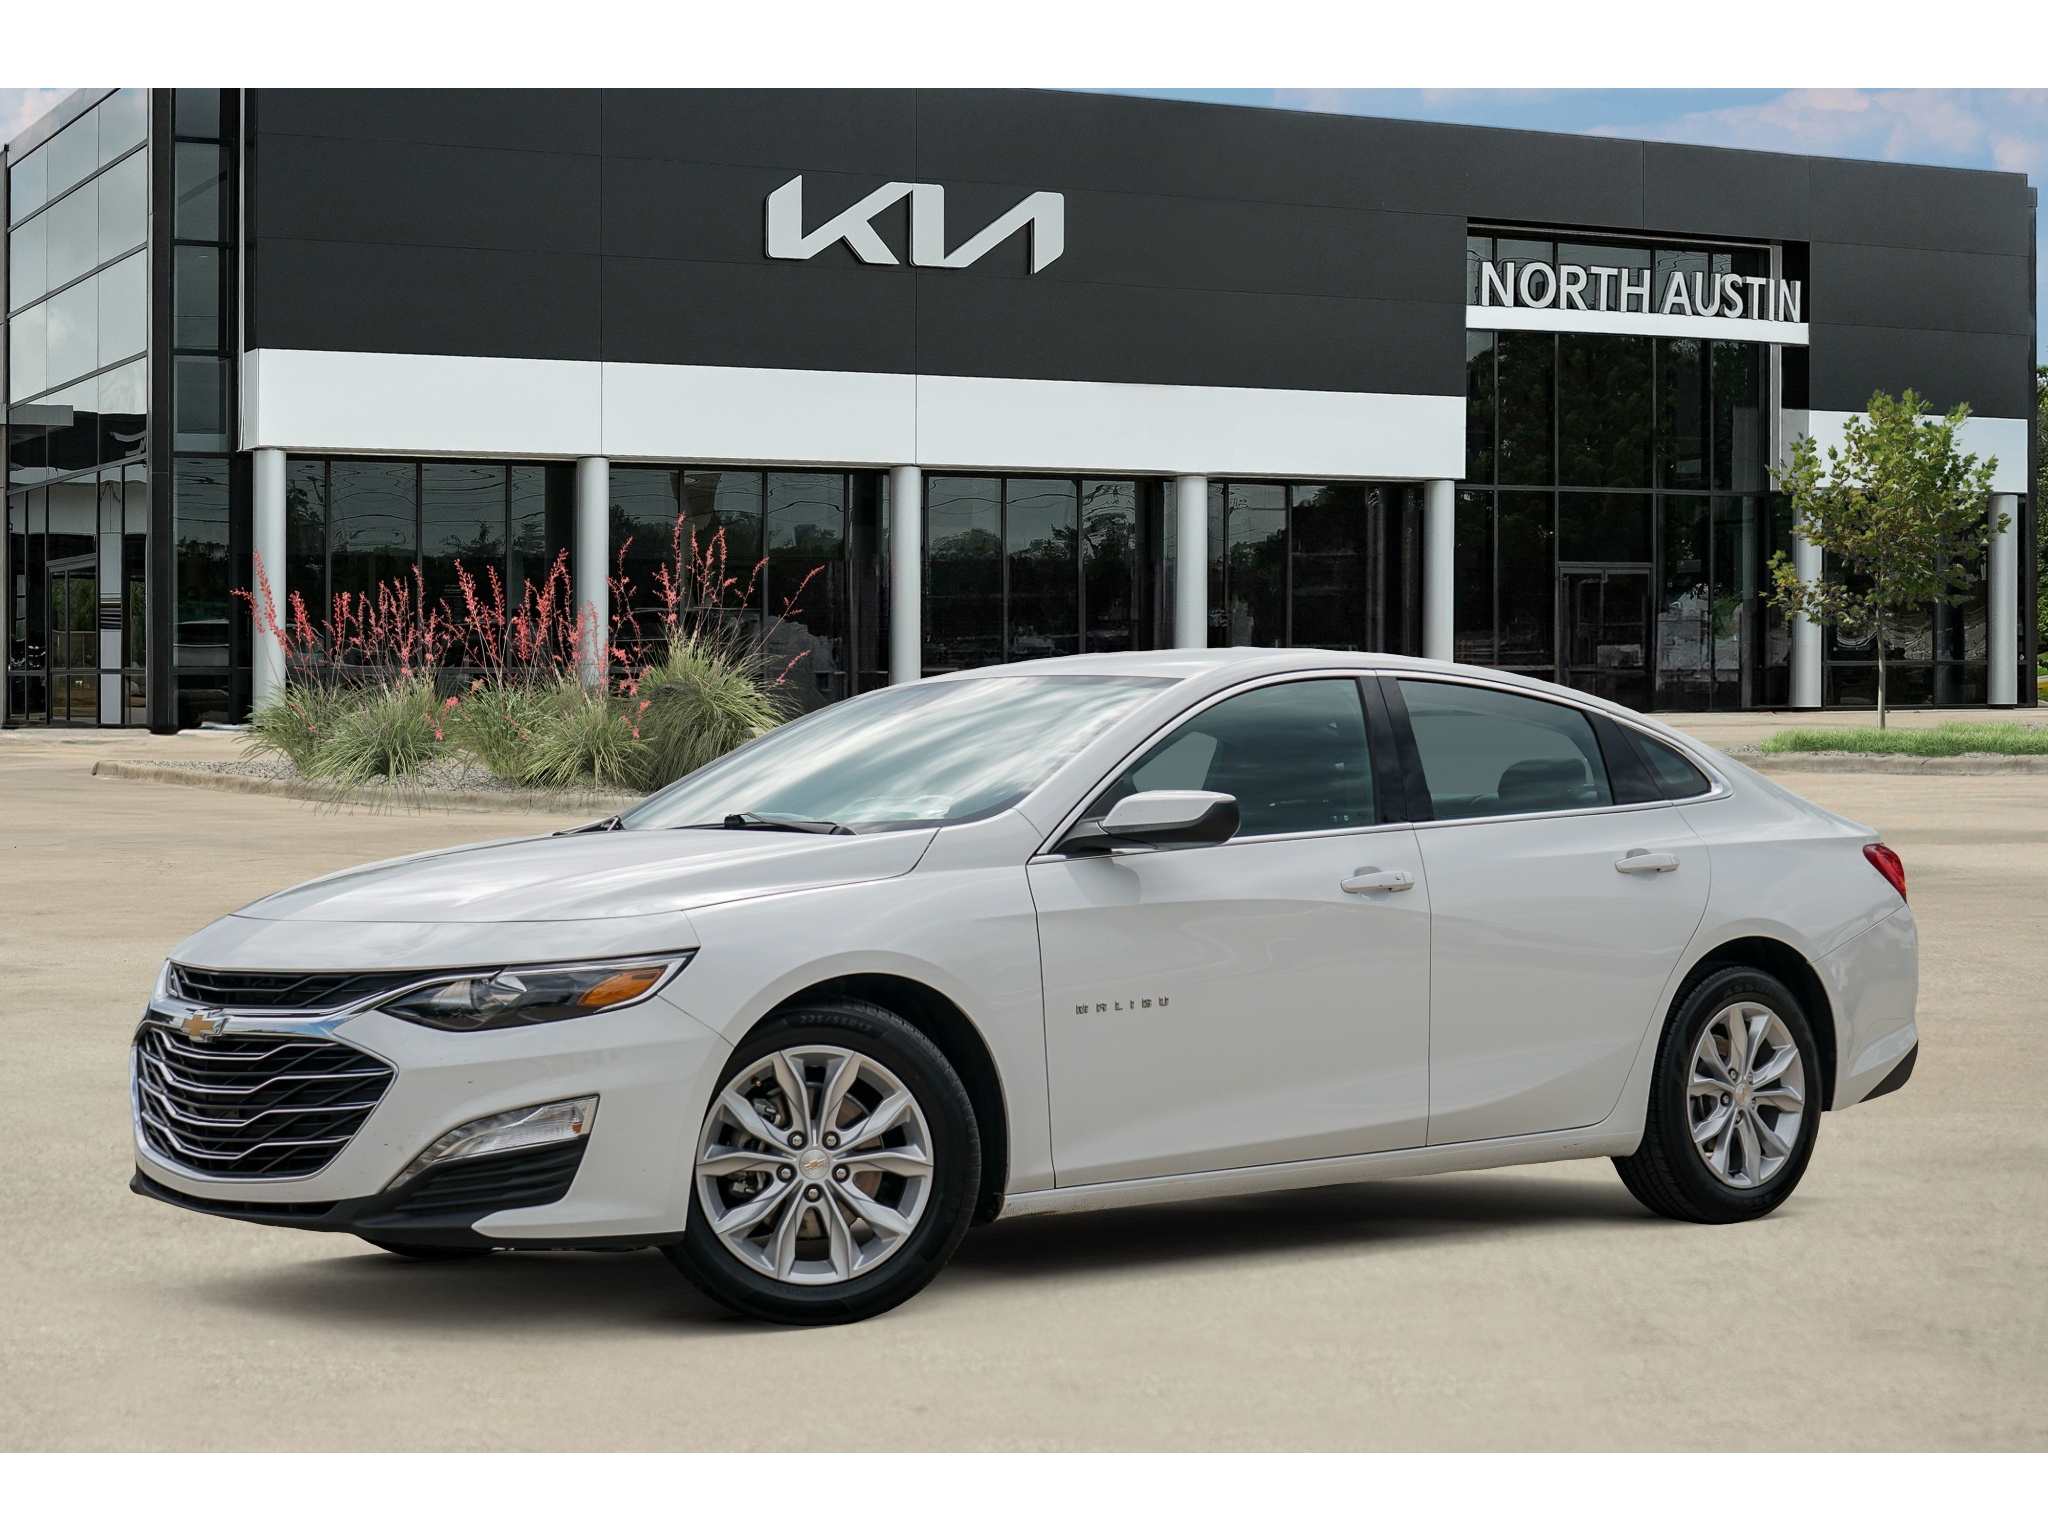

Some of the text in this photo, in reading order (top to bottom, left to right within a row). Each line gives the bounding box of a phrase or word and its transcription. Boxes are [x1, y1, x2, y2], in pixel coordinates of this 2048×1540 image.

[1481, 261, 1801, 323] NORTH AUSTIN
[1076, 997, 1169, 1014] MALIBU
